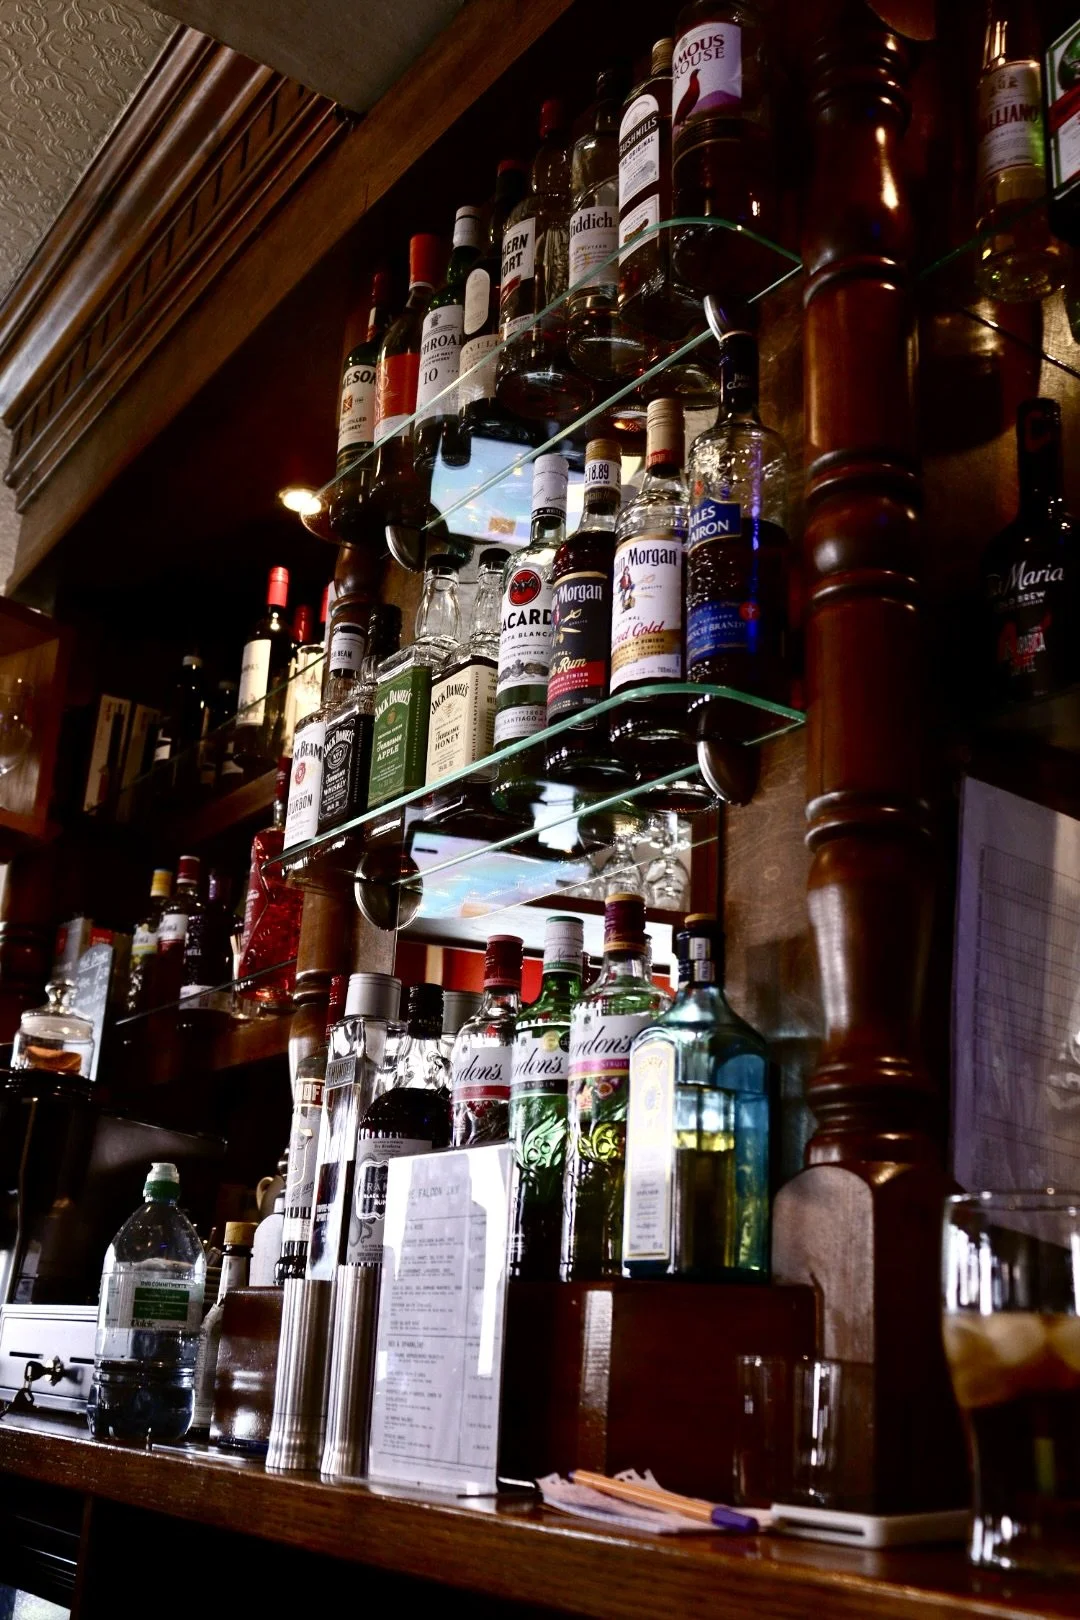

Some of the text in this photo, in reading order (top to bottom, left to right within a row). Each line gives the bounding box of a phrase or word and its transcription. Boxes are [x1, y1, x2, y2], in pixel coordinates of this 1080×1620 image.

[619, 116, 657, 153] BUSHMILLS
[629, 136, 654, 161] ORIGINAL
[424, 368, 438, 385] 10
[628, 547, 677, 566] Morgan
[1004, 561, 1064, 593] Maria
[559, 584, 603, 604] Morgan
[1018, 591, 1046, 602] BREW
[632, 621, 665, 639] Gold
[338, 650, 352, 659] BEAM
[558, 657, 587, 672] Rum
[375, 697, 388, 722] JACK
[431, 693, 446, 714] JACK
[504, 715, 537, 724] SANTIAGO
[301, 741, 322, 762] BEAM
[324, 737, 336, 757] JACK
[434, 733, 460, 751] HONEY
[377, 744, 399, 761] APPLE
